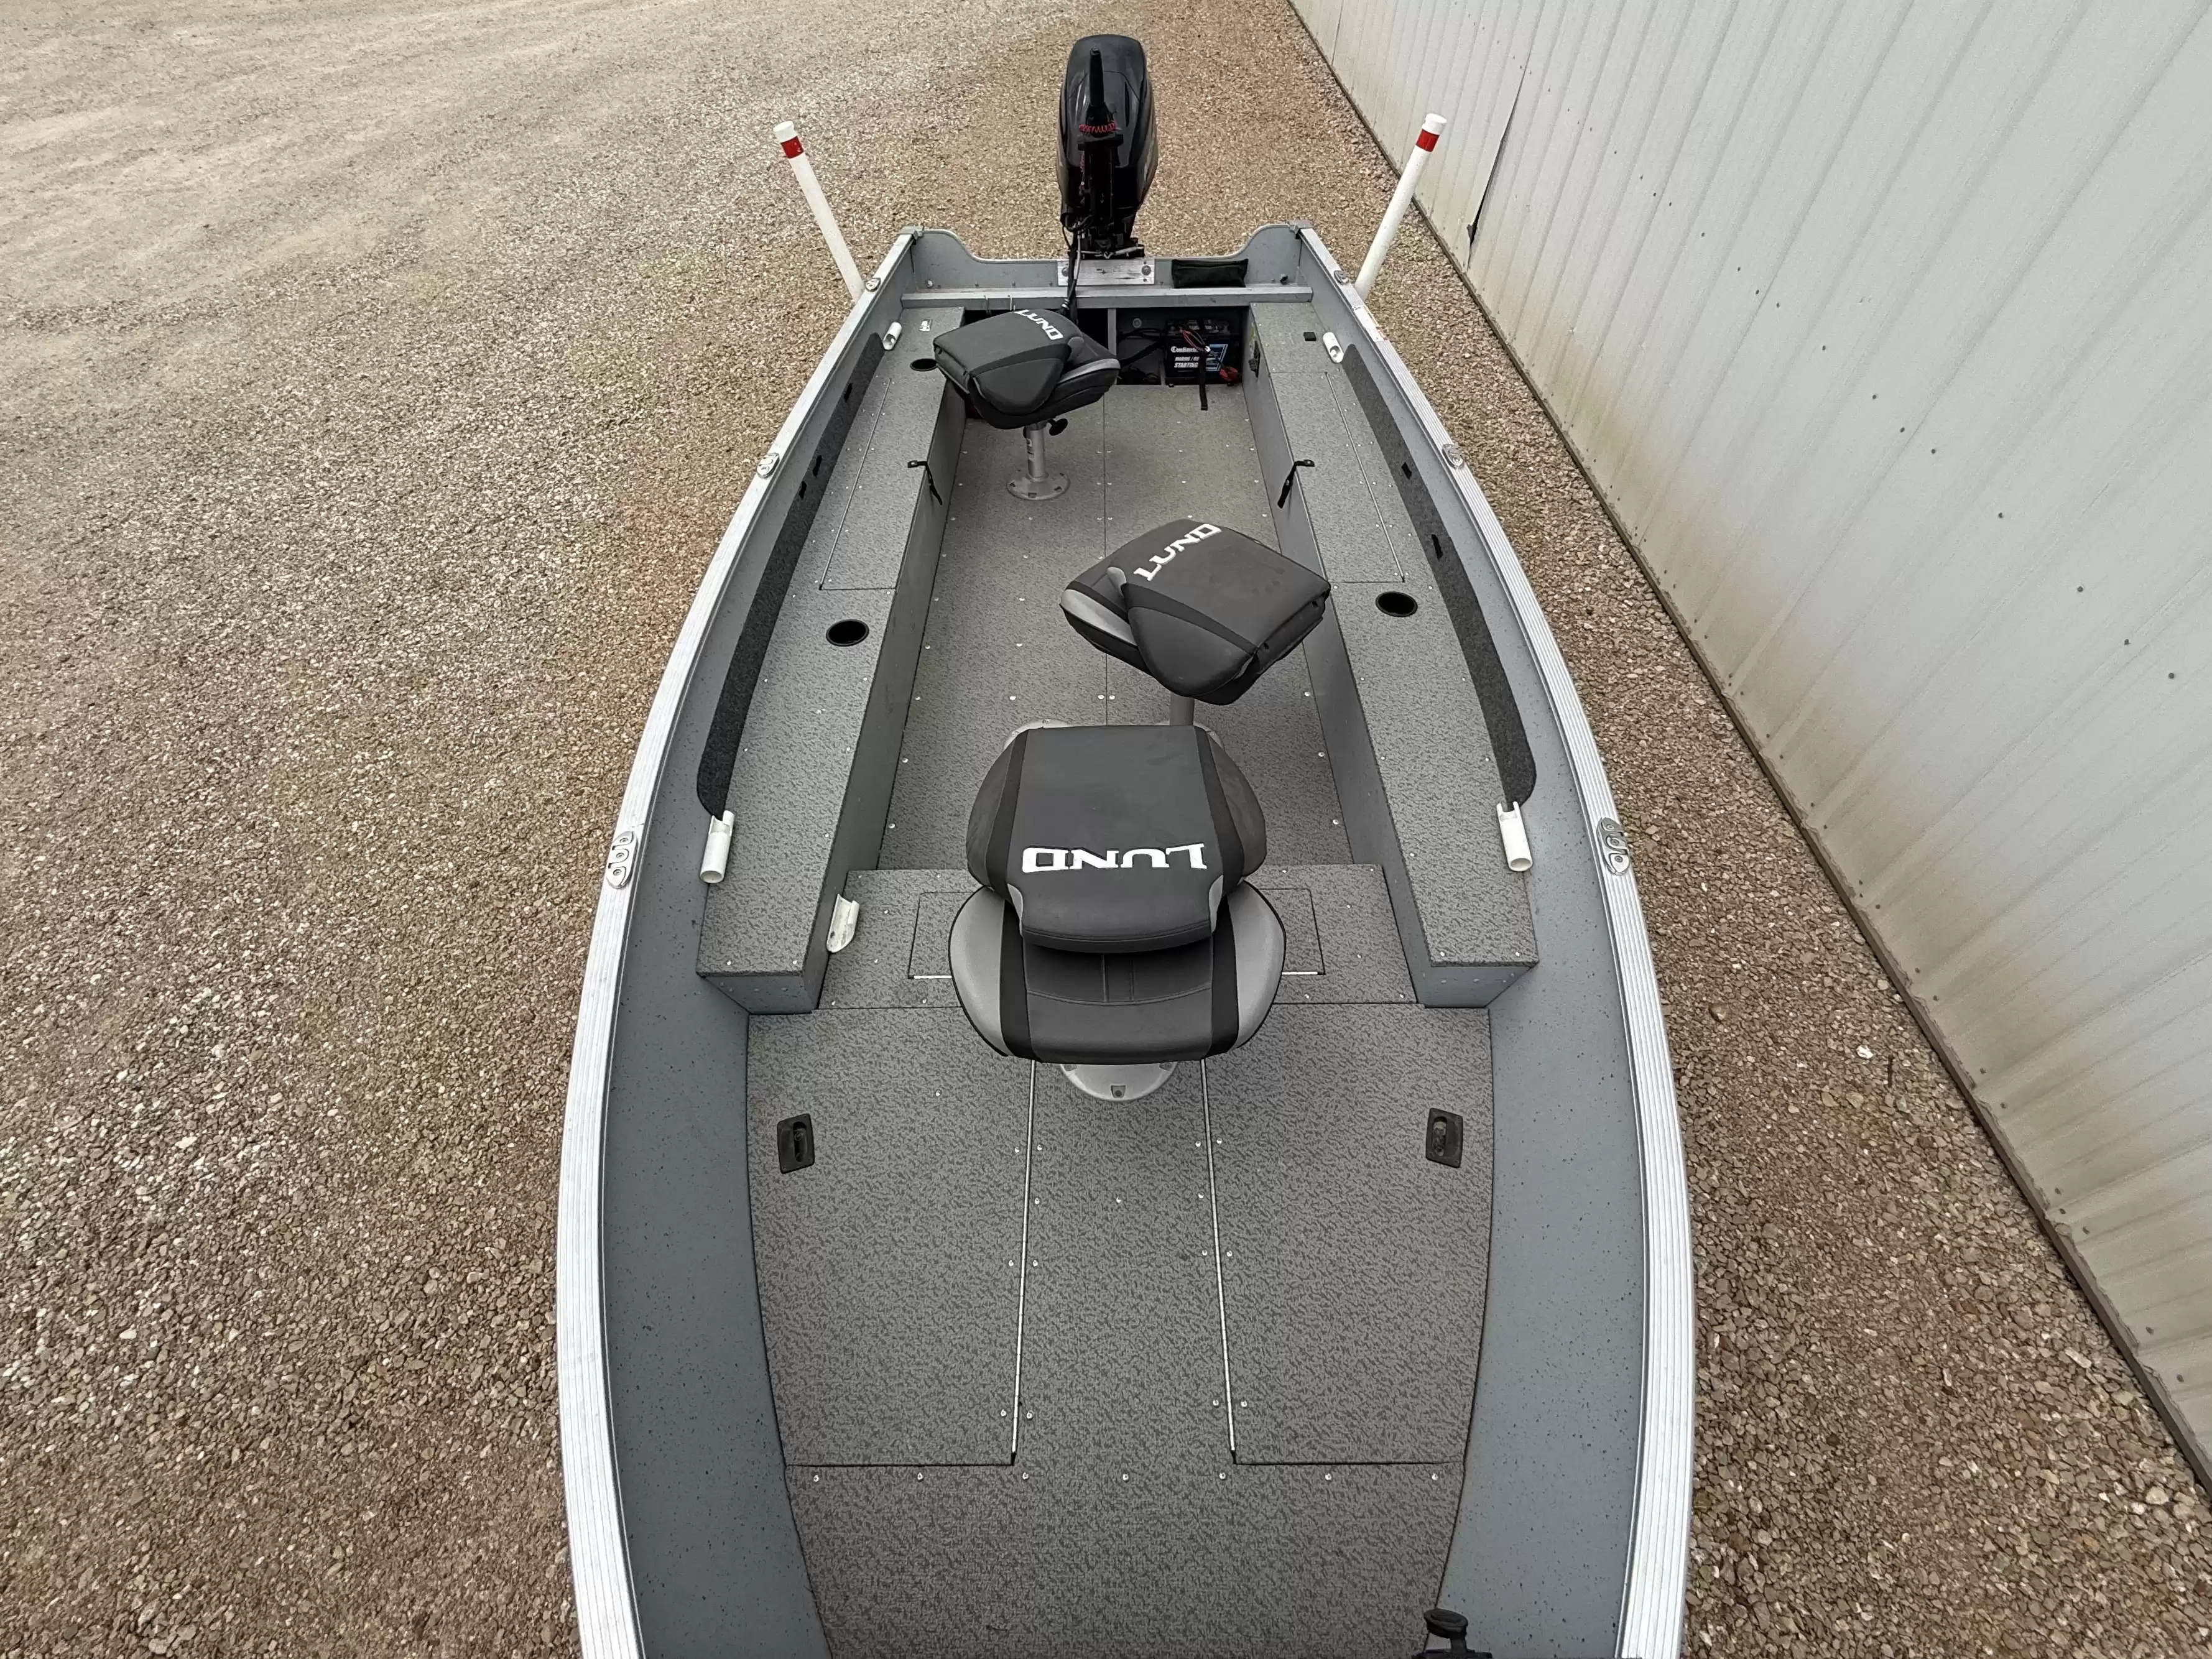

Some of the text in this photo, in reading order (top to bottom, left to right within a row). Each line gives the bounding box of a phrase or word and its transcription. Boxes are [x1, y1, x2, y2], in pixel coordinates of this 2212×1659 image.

[1014, 309, 1064, 340] LUND
[1133, 524, 1222, 581] LUND
[1022, 843, 1208, 873] LUND
